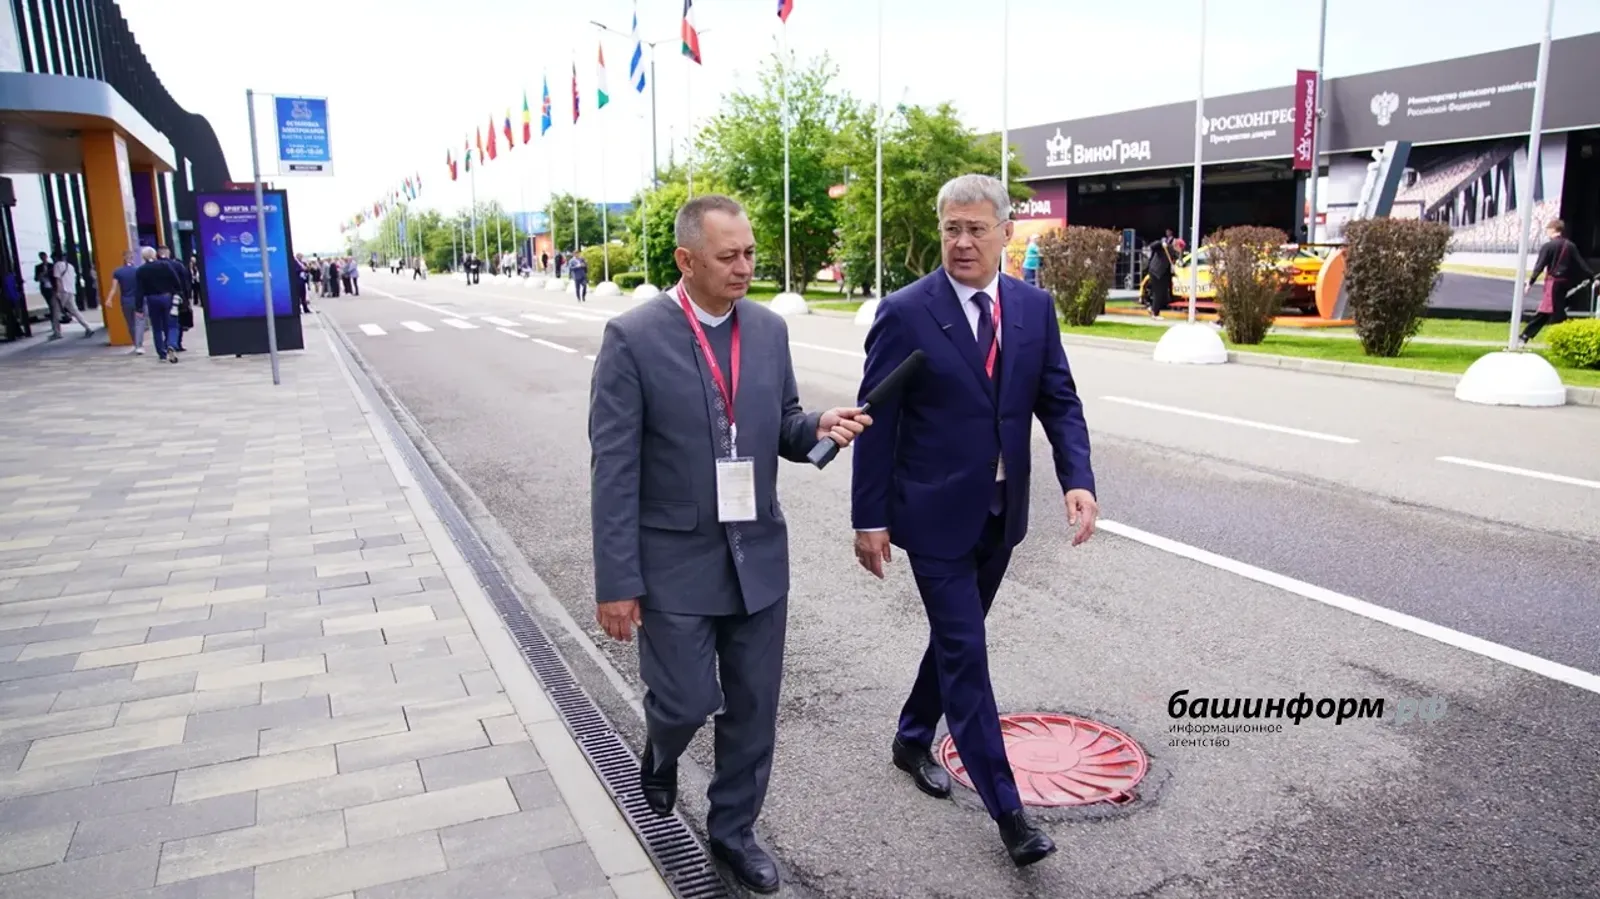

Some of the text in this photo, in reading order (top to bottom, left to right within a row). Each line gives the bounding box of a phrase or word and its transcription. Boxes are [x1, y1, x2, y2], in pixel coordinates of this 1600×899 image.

[1210, 107, 1296, 132] РОСКОНГРЕС
[1304, 79, 1314, 137] VinoGrad
[1074, 138, 1151, 164] ВиноГрад
